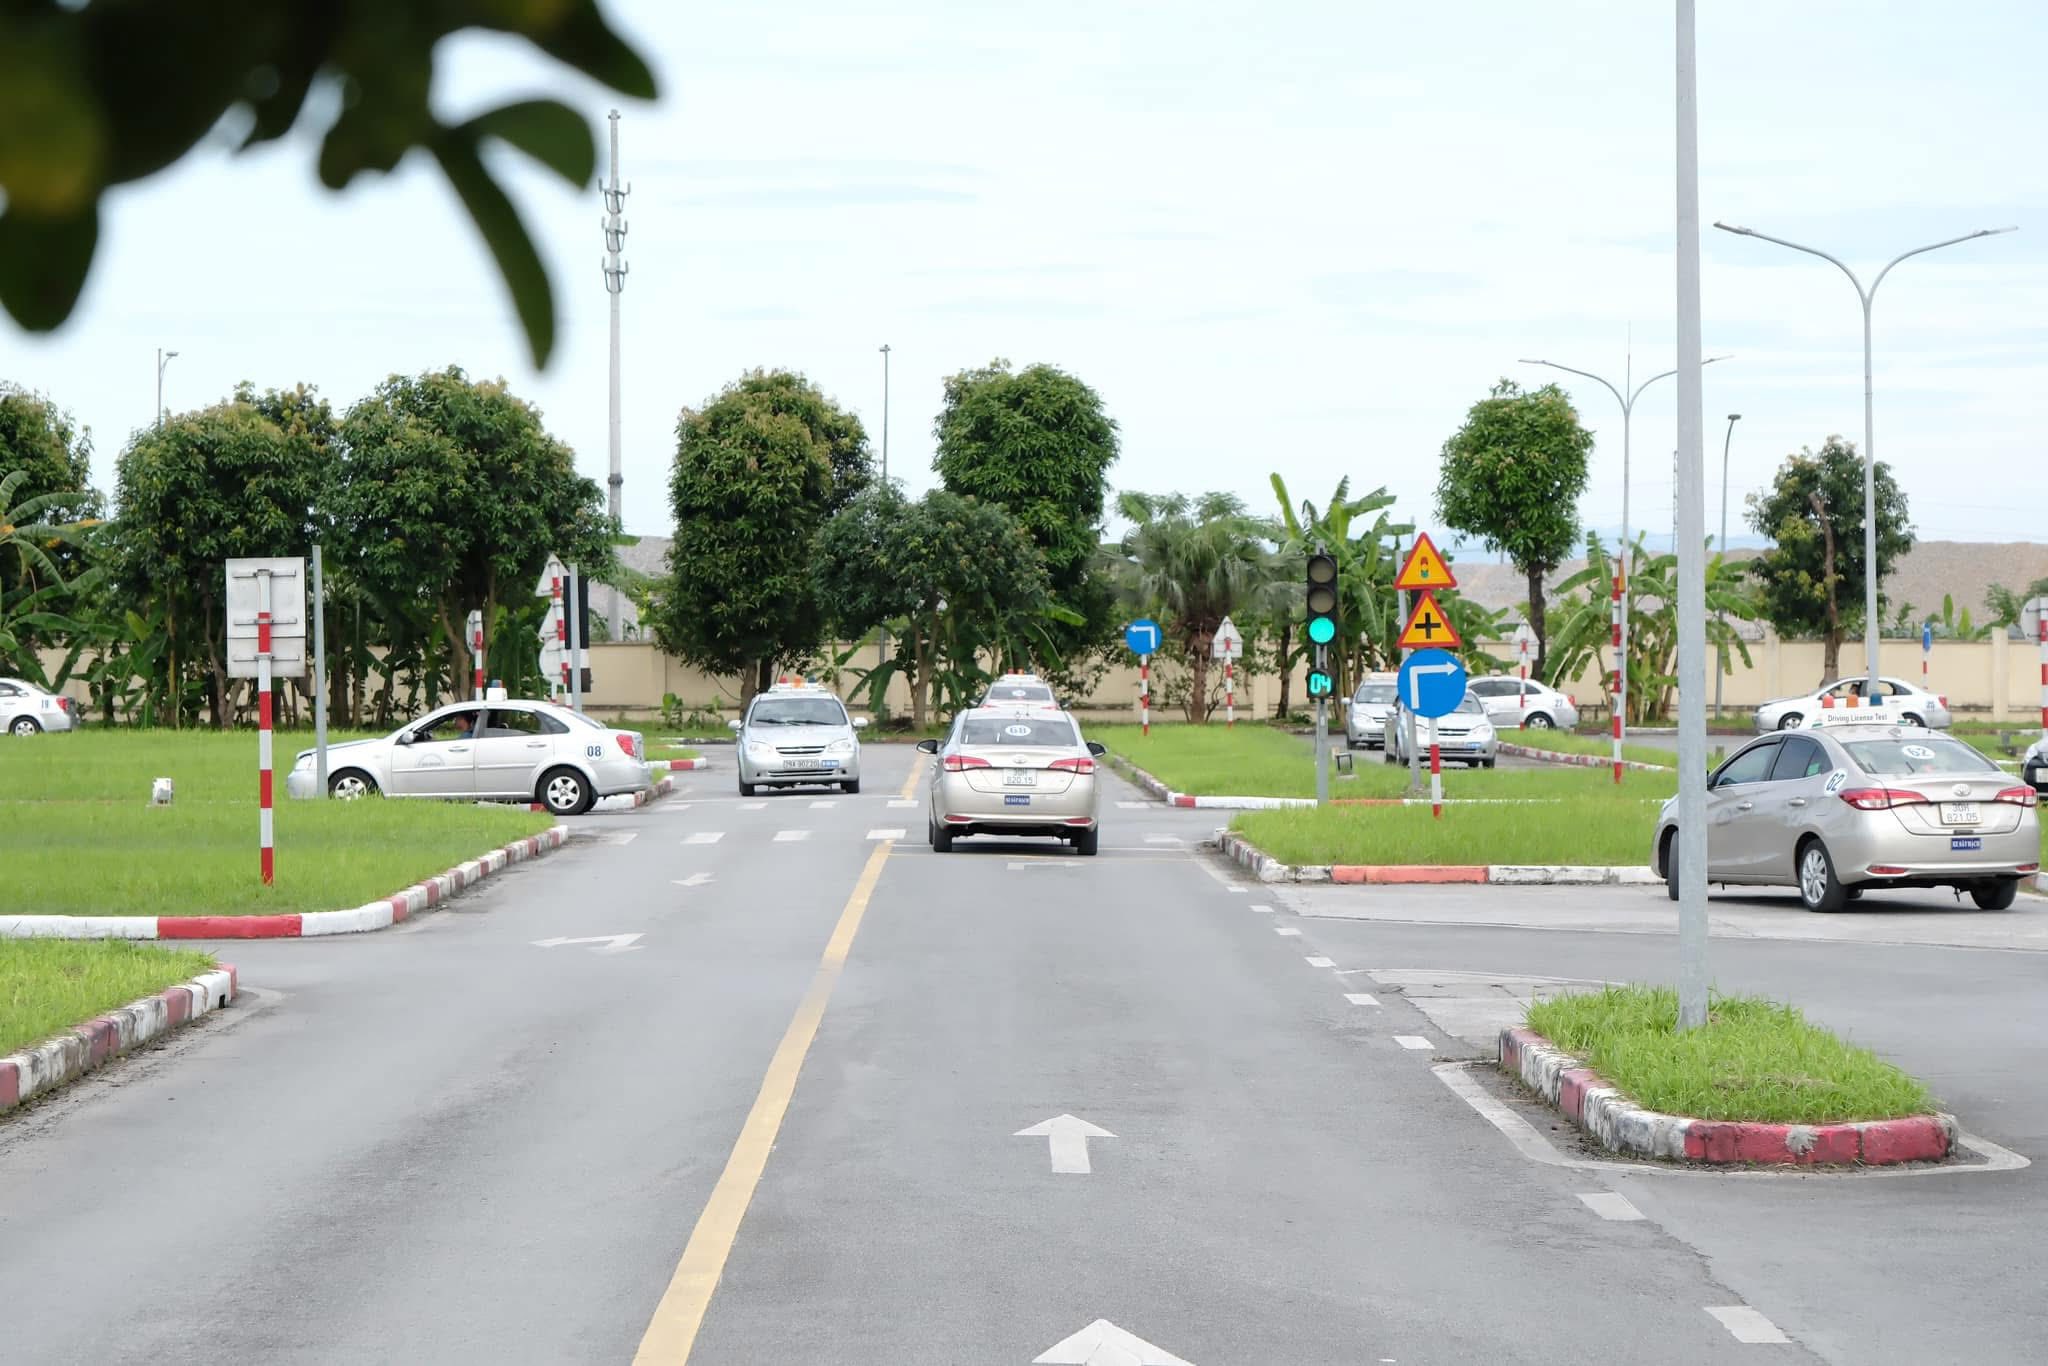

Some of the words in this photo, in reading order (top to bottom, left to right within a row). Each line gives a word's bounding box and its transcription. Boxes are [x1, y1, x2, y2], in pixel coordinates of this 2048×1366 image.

[1310, 673, 1332, 694] 04
[1828, 714, 1850, 724] Driving
[1850, 714, 1873, 722] License
[1875, 712, 1888, 721] Test
[587, 745, 601, 757] 08
[1826, 772, 1846, 792] 62
